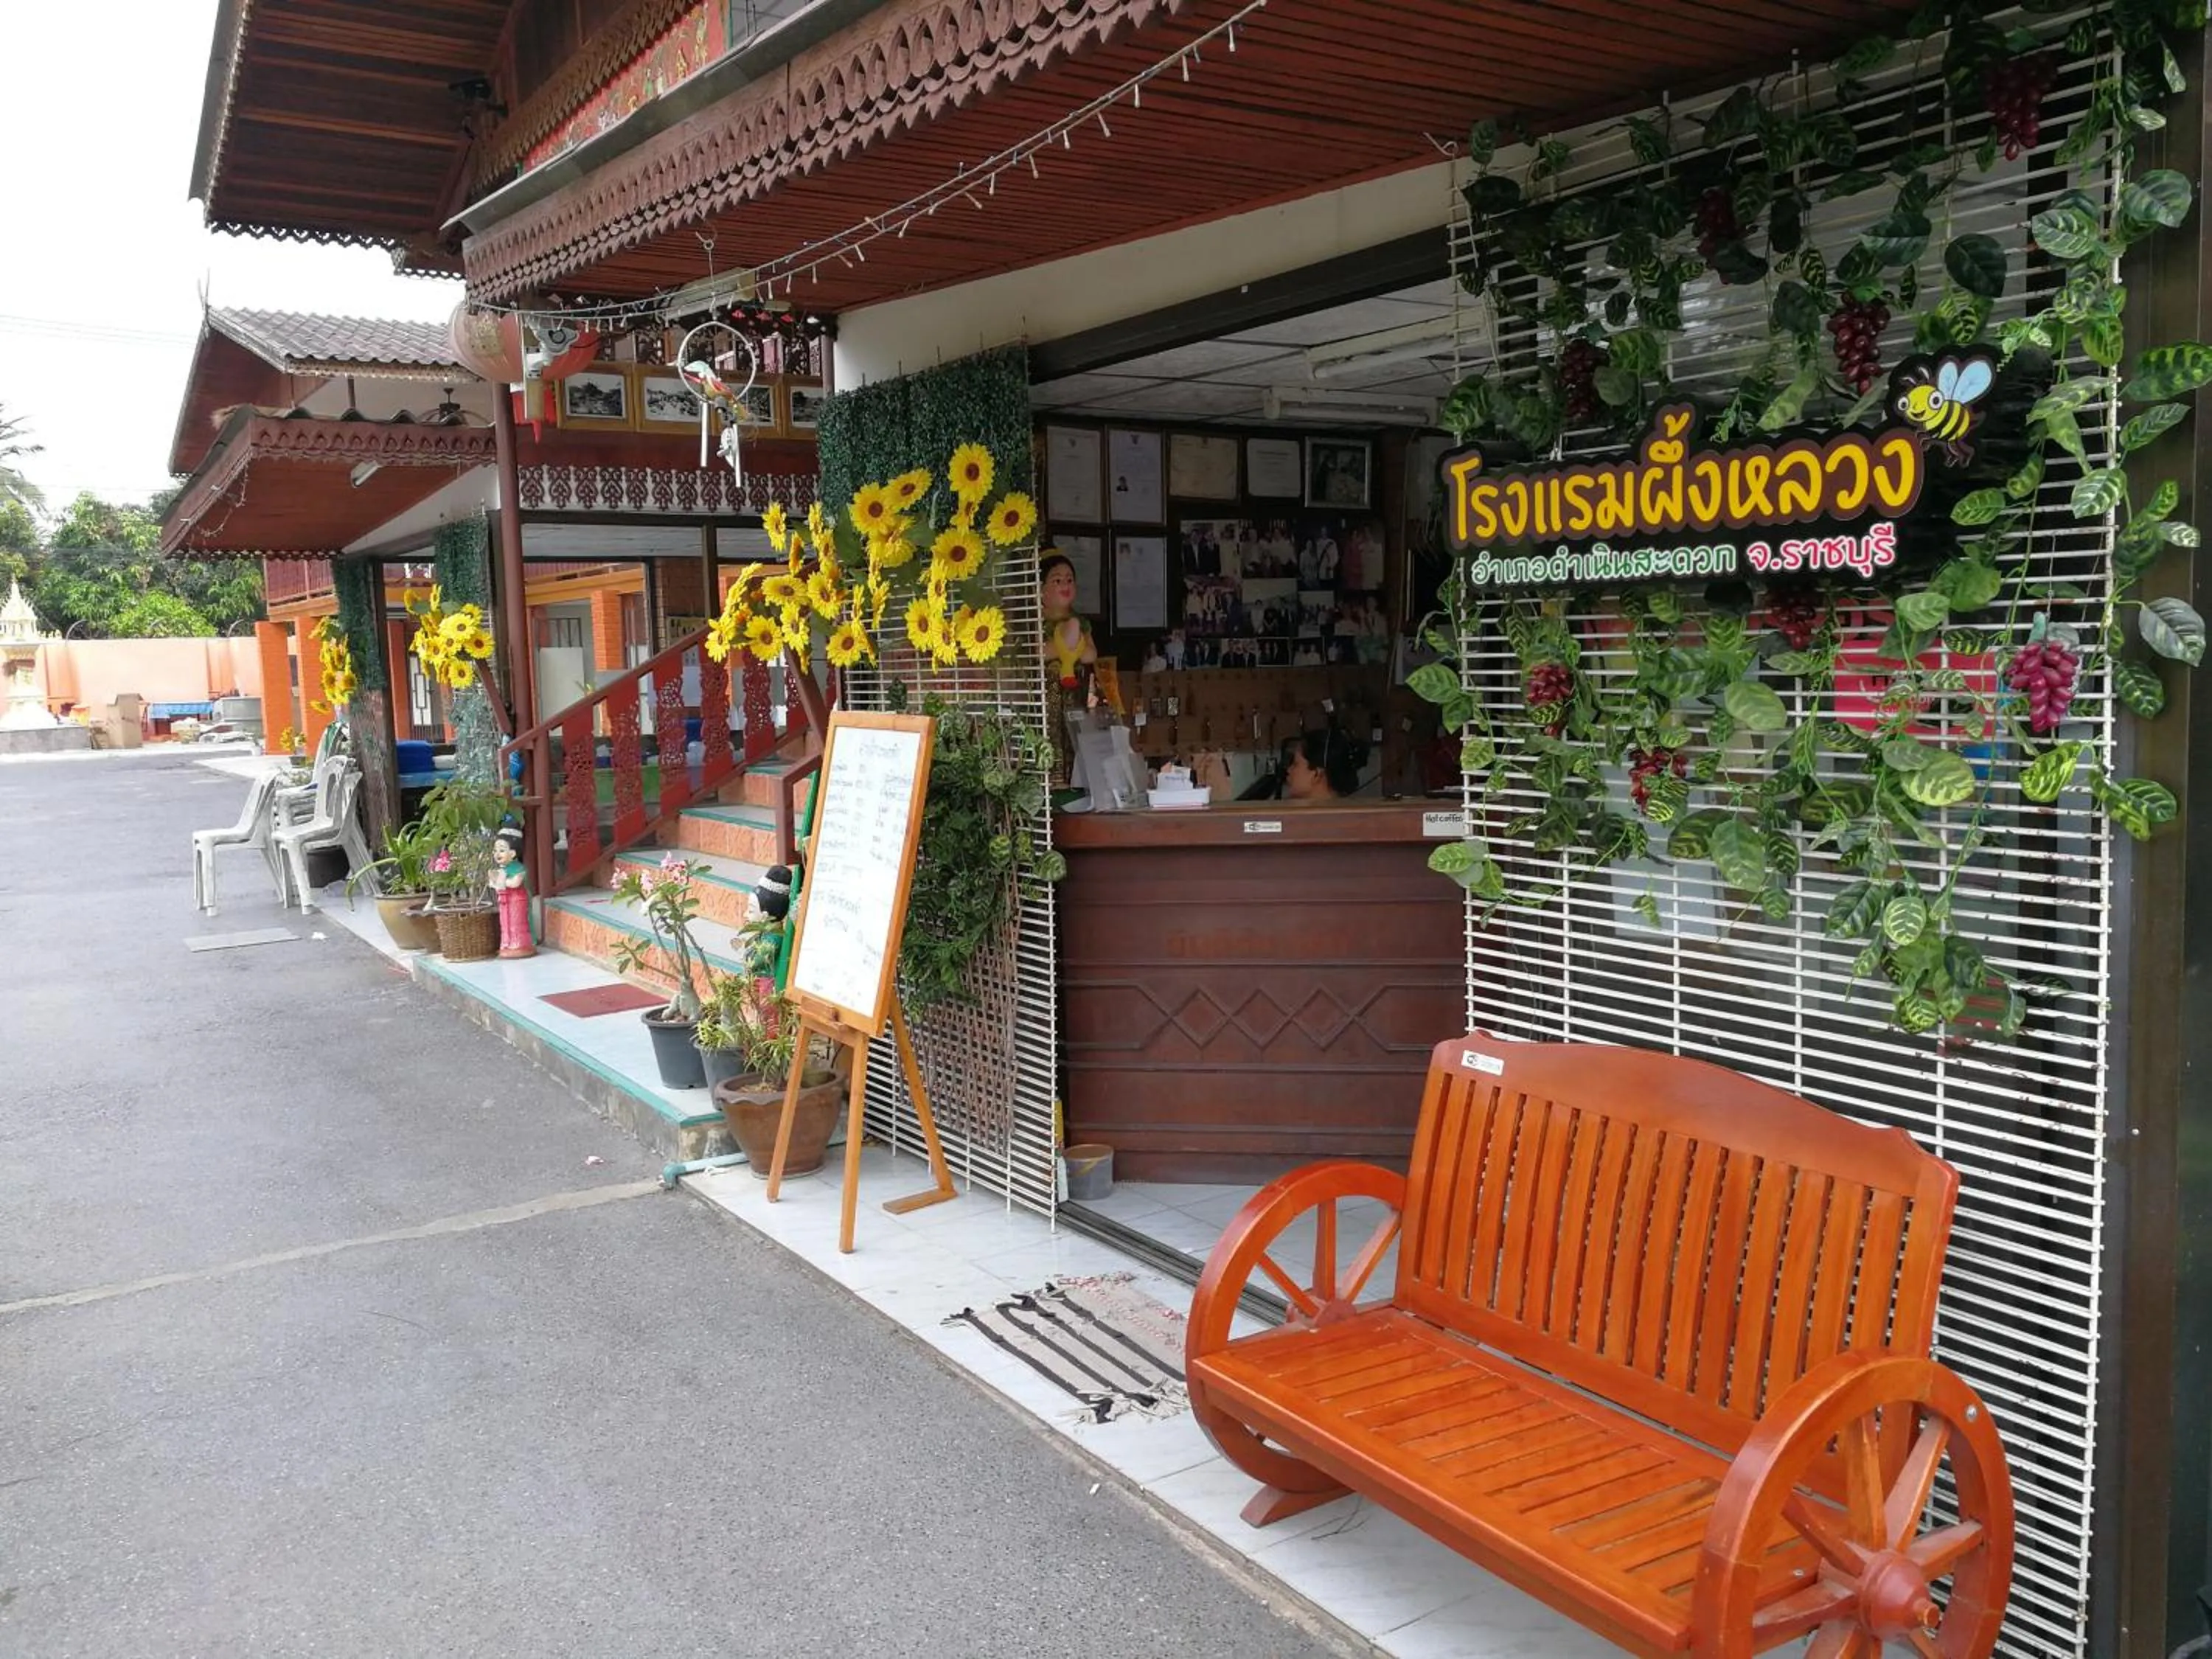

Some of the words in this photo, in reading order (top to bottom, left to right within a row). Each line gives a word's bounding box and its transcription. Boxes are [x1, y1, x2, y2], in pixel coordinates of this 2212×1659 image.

[1451, 411, 1916, 540] โรงแรมผึ้งหลวง
[1472, 543, 1736, 584] อำเภอดำเนินสะดวก
[1747, 521, 1896, 577] จ.ราชบุรี
